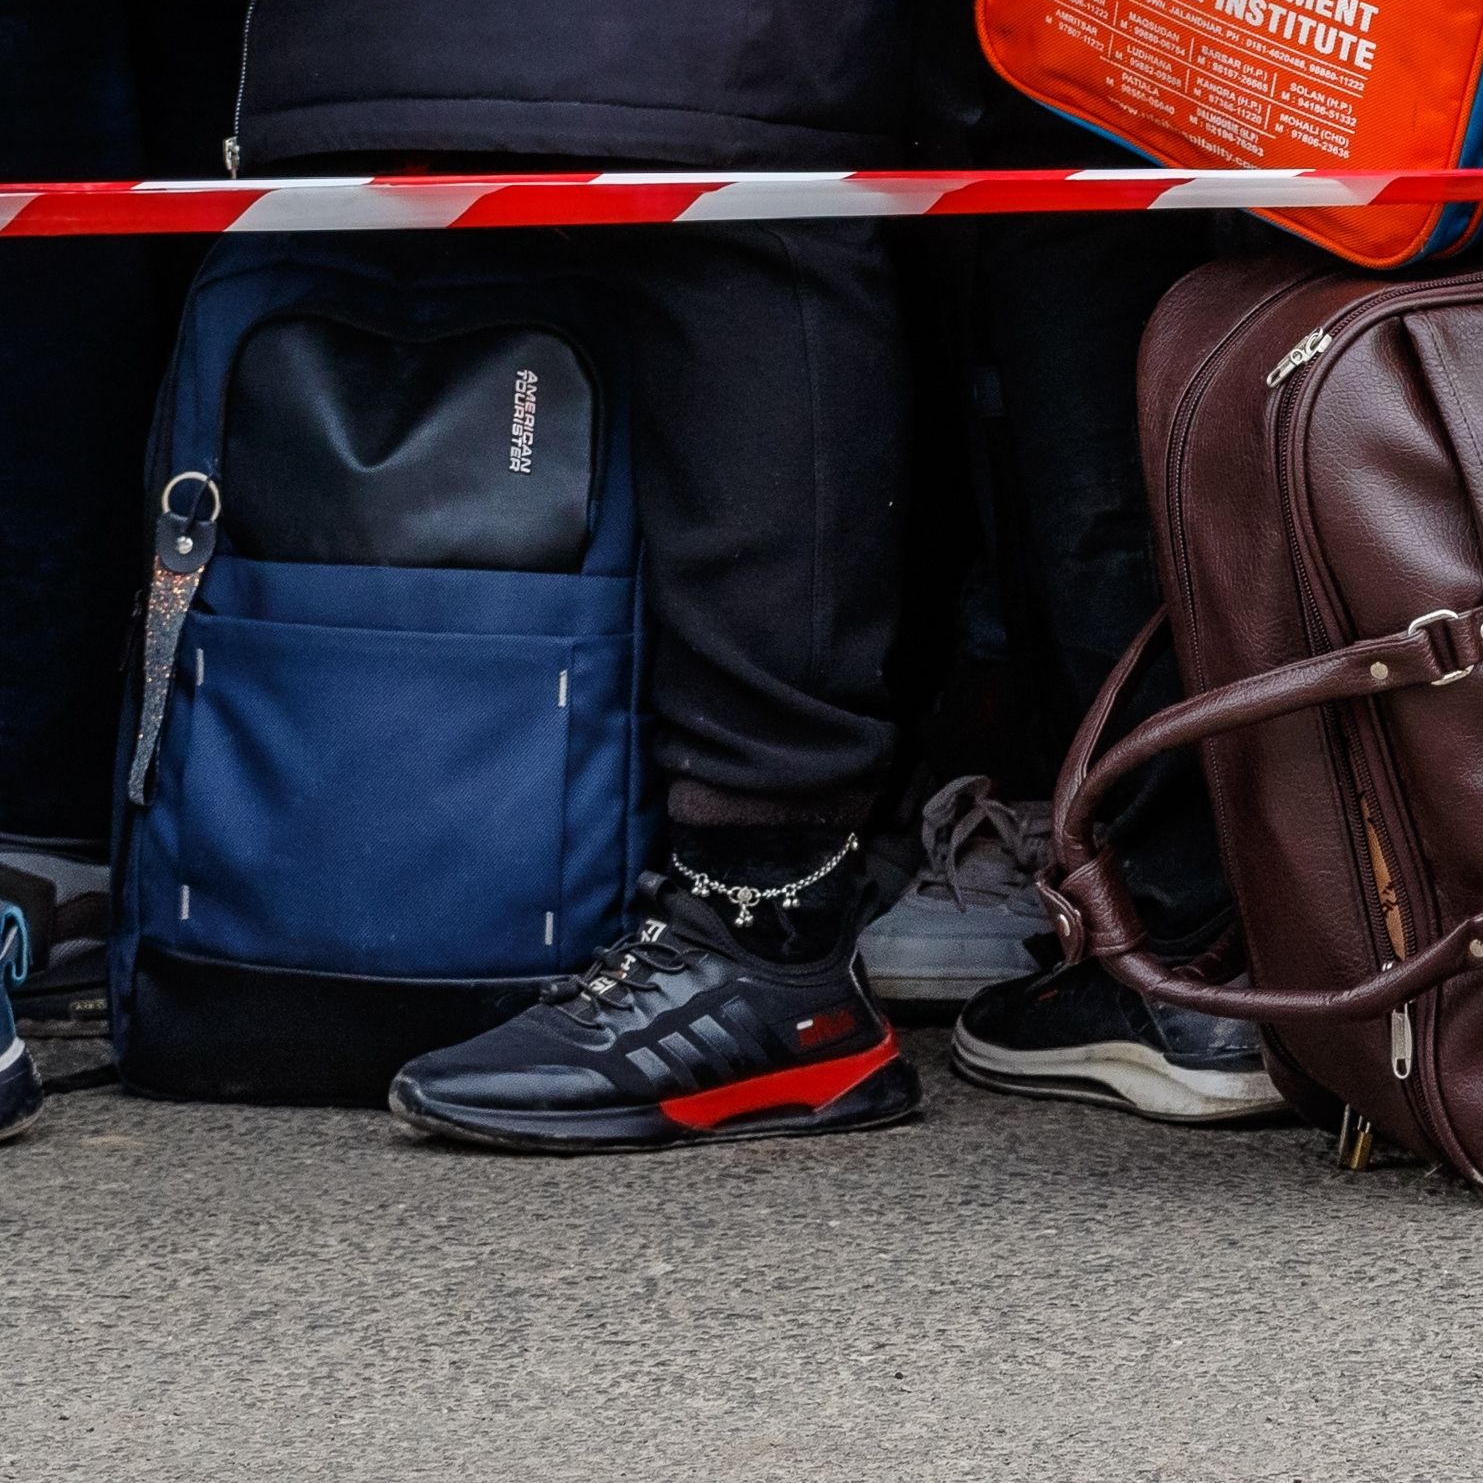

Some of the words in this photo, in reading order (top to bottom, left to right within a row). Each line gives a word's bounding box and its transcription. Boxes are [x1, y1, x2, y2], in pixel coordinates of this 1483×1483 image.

[1055, 9, 1098, 36] AMRITSAR
[1128, 11, 1180, 42] MAQSUDAN
[1226, 30, 1240, 42] PH
[1126, 44, 1172, 72] LUDHIANA
[1121, 72, 1160, 98] PATIALA
[1196, 77, 1236, 101] KANGRA
[1289, 82, 1325, 104] SOLAN
[1279, 113, 1319, 136] MOHALI
[1320, 128, 1350, 149] (CHD)
[508, 369, 529, 472] TOURISTER
[519, 370, 539, 474] AMERICAN
